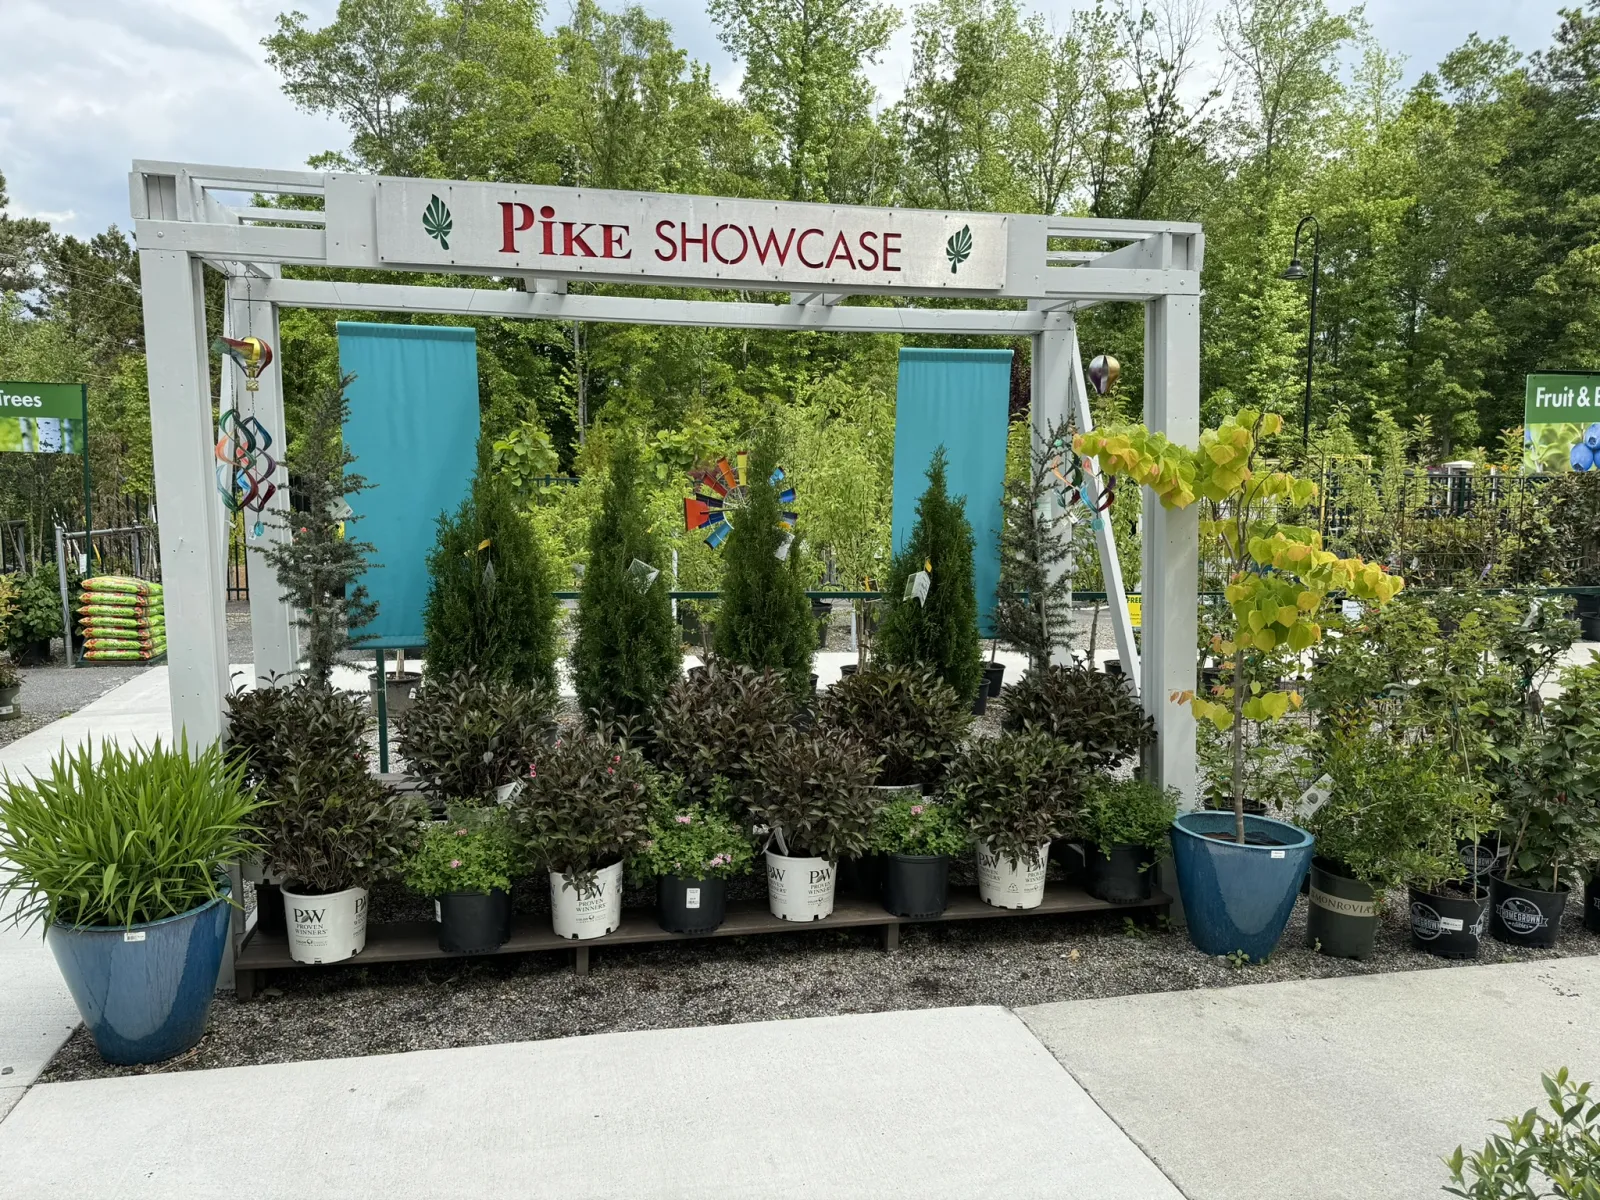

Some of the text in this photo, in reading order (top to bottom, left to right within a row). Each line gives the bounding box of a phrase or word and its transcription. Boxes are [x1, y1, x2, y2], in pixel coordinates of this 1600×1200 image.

[654, 219, 902, 272] SHOWCASE
[1535, 385, 1575, 408] Fruit
[1576, 385, 1591, 408] &
[809, 867, 833, 884] PW
[575, 903, 606, 913] WINNERS
[578, 898, 604, 907] PROVEN
[1314, 892, 1371, 914] MONROVIA
[293, 907, 326, 924] PW
[1501, 908, 1541, 925] HOMEGROWN
[295, 928, 327, 936] WINNERS
